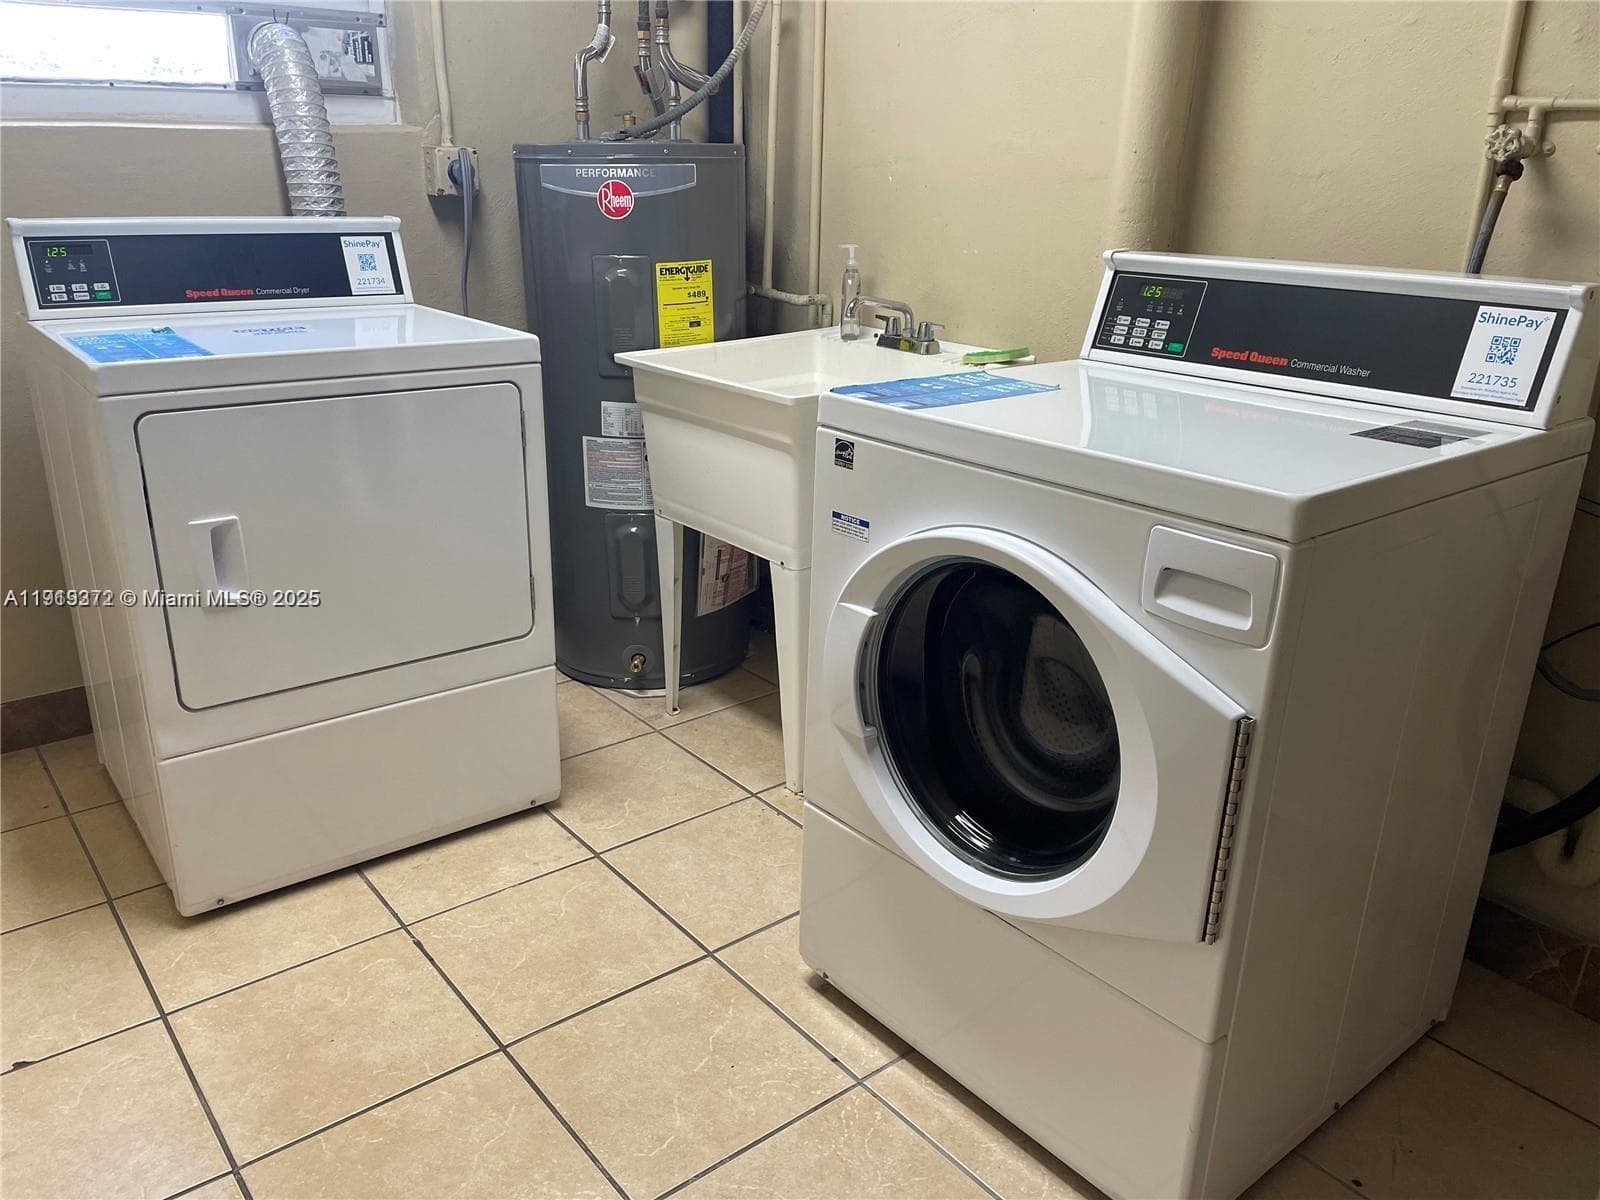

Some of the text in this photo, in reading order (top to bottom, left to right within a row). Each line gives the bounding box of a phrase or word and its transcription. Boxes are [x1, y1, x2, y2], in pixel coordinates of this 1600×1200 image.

[575, 168, 657, 178] PERFORMANCE
[602, 181, 632, 213] Rheem
[343, 239, 381, 249] ShinePay
[357, 277, 386, 286] 221734
[185, 286, 310, 299] Speed Queen Commercial Dryer
[687, 290, 707, 299] $489
[1478, 311, 1544, 331] ShinePay
[1210, 346, 1371, 379] Speed Queen Commercial Washer
[1467, 372, 1519, 389] 221735
[840, 514, 861, 525] NOTICE
